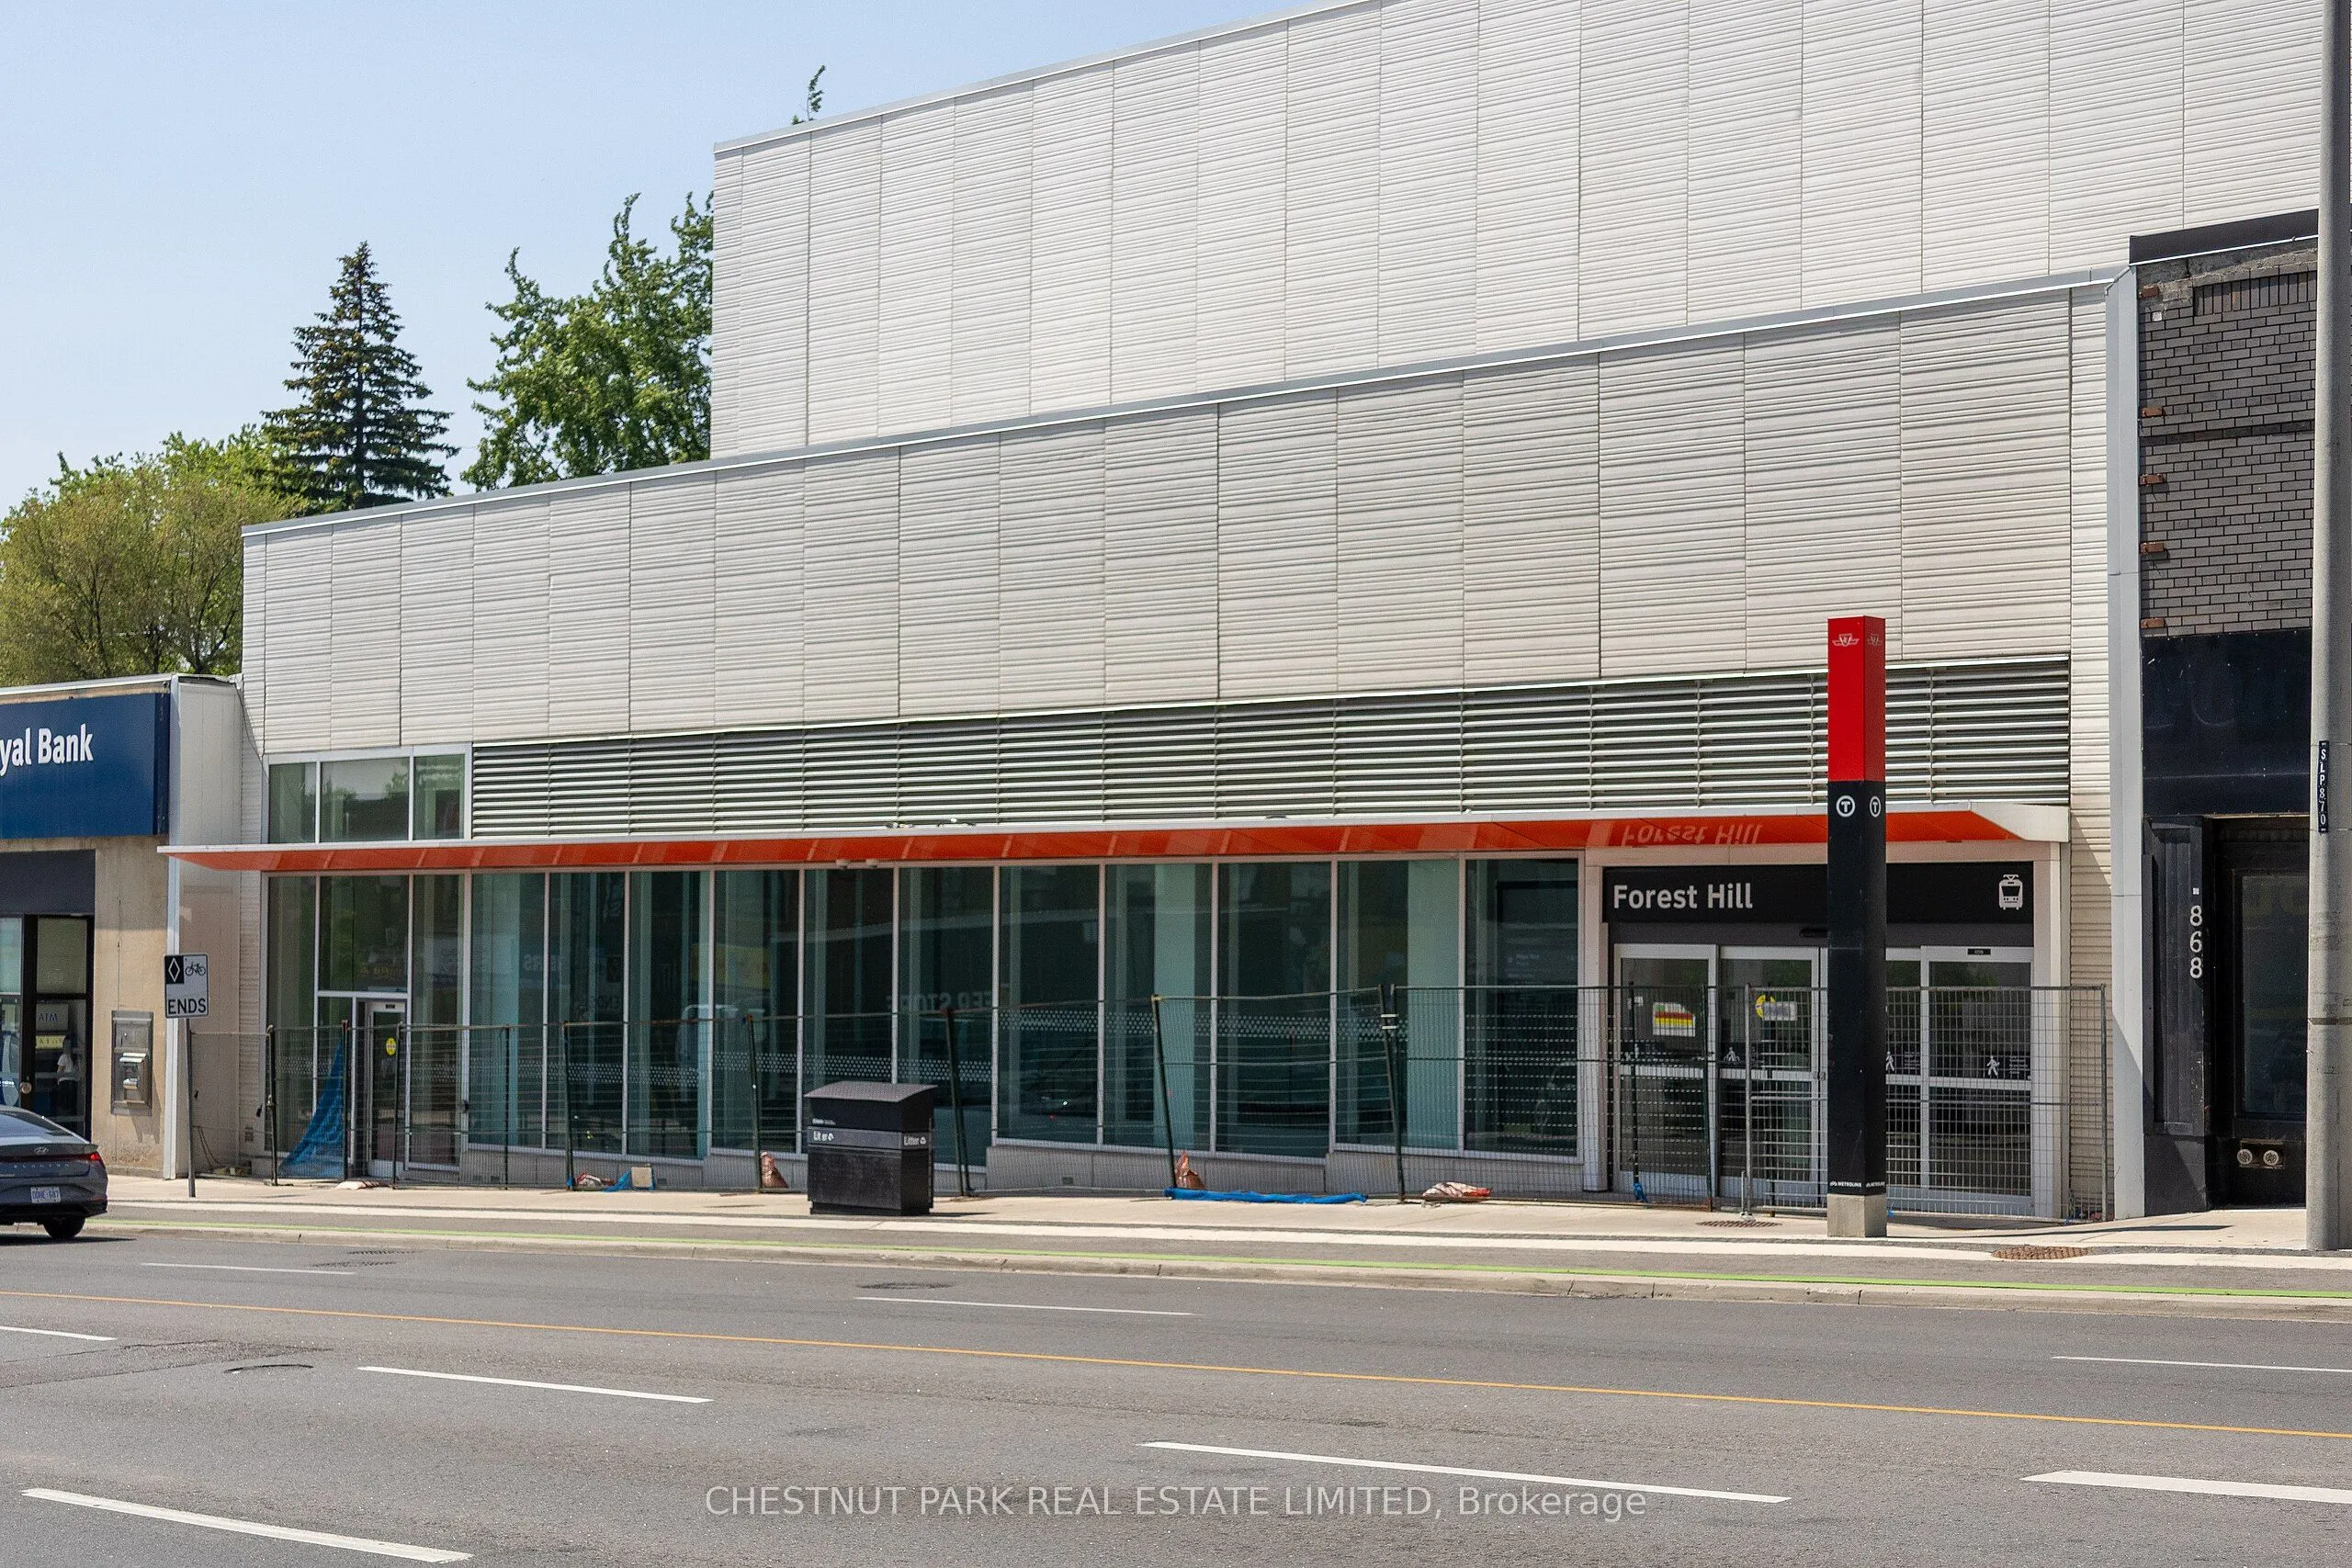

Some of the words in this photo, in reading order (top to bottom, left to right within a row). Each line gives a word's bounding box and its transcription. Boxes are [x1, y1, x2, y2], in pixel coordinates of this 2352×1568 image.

[38, 723, 94, 764] Bank
[1613, 885, 1698, 909] Forest
[1707, 882, 1754, 909] Hill
[2189, 905, 2203, 979] 868
[168, 998, 207, 1014] ENDS
